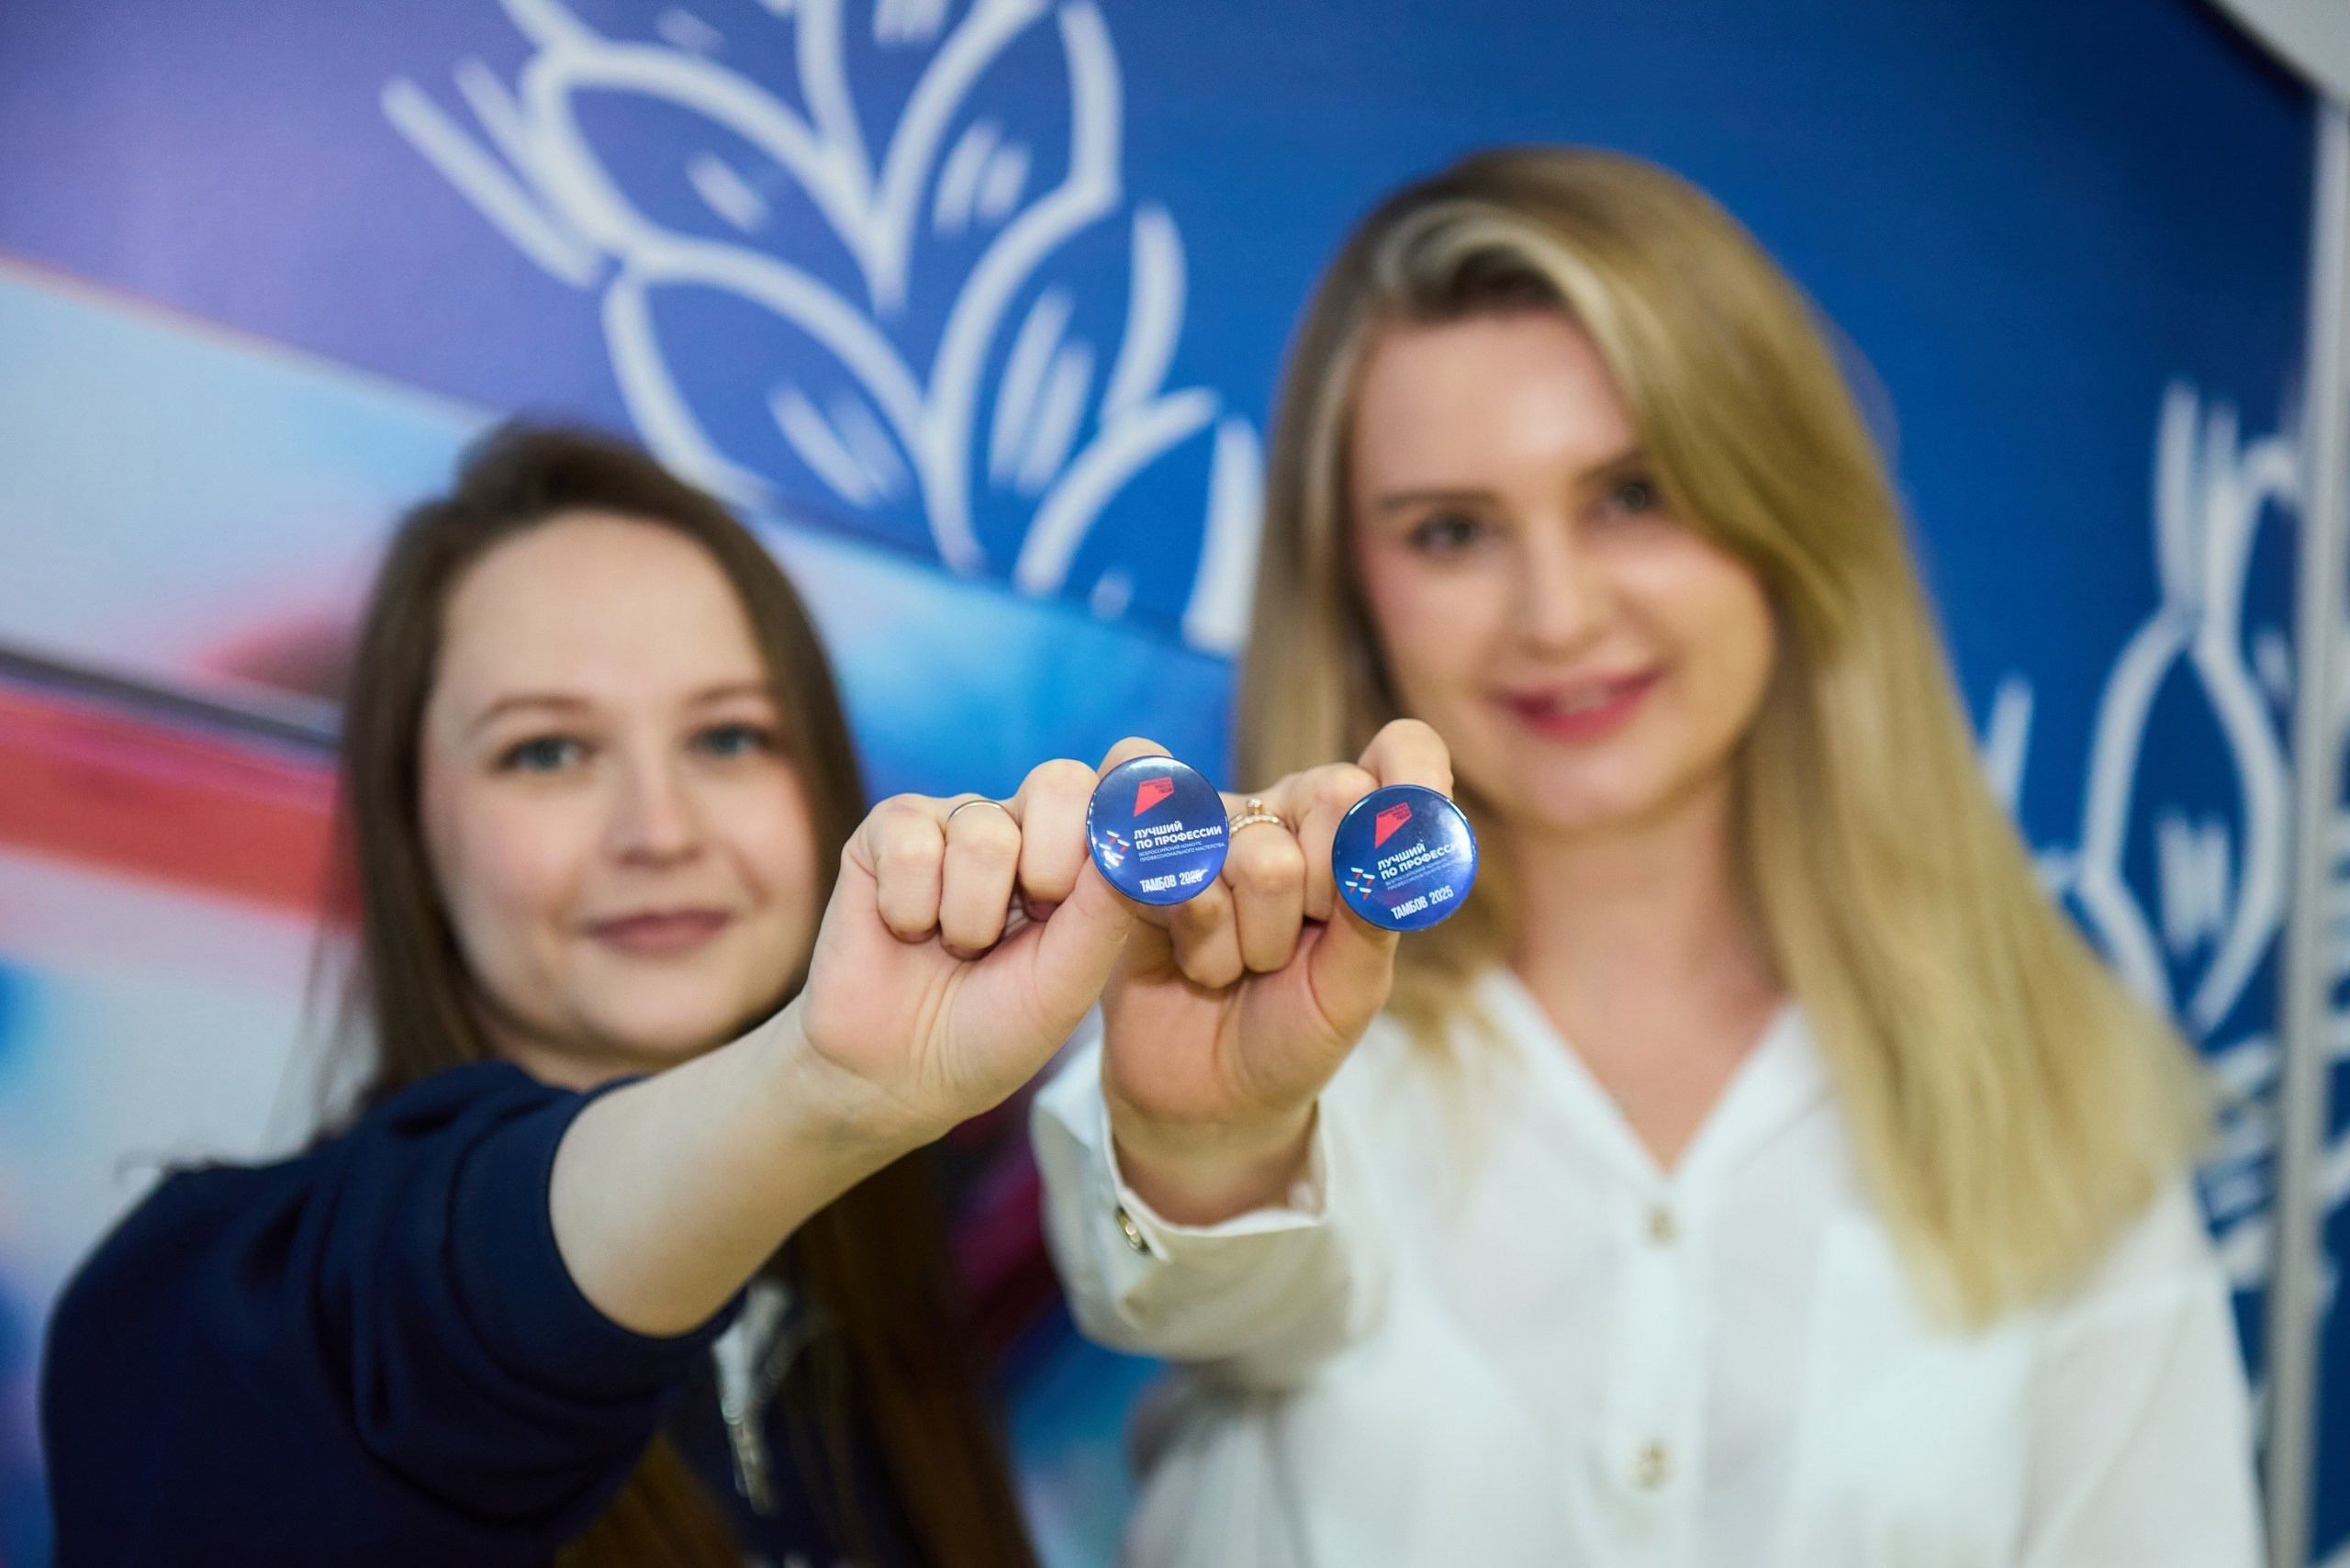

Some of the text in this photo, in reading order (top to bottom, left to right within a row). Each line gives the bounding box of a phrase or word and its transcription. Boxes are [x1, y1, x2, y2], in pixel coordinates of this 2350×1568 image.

[1134, 821, 1182, 839] ЛУЧШИЙ
[1136, 825, 1222, 850] ПО ПРОФЕССИИ
[1377, 843, 1426, 870] ЛУЧШИЙ
[1381, 867, 1398, 879] ПО
[1399, 843, 1457, 872] ПРОФЕСС
[1139, 875, 1177, 892] ТАМБОВ
[1391, 885, 1454, 920] ТАМБОВ 2025
